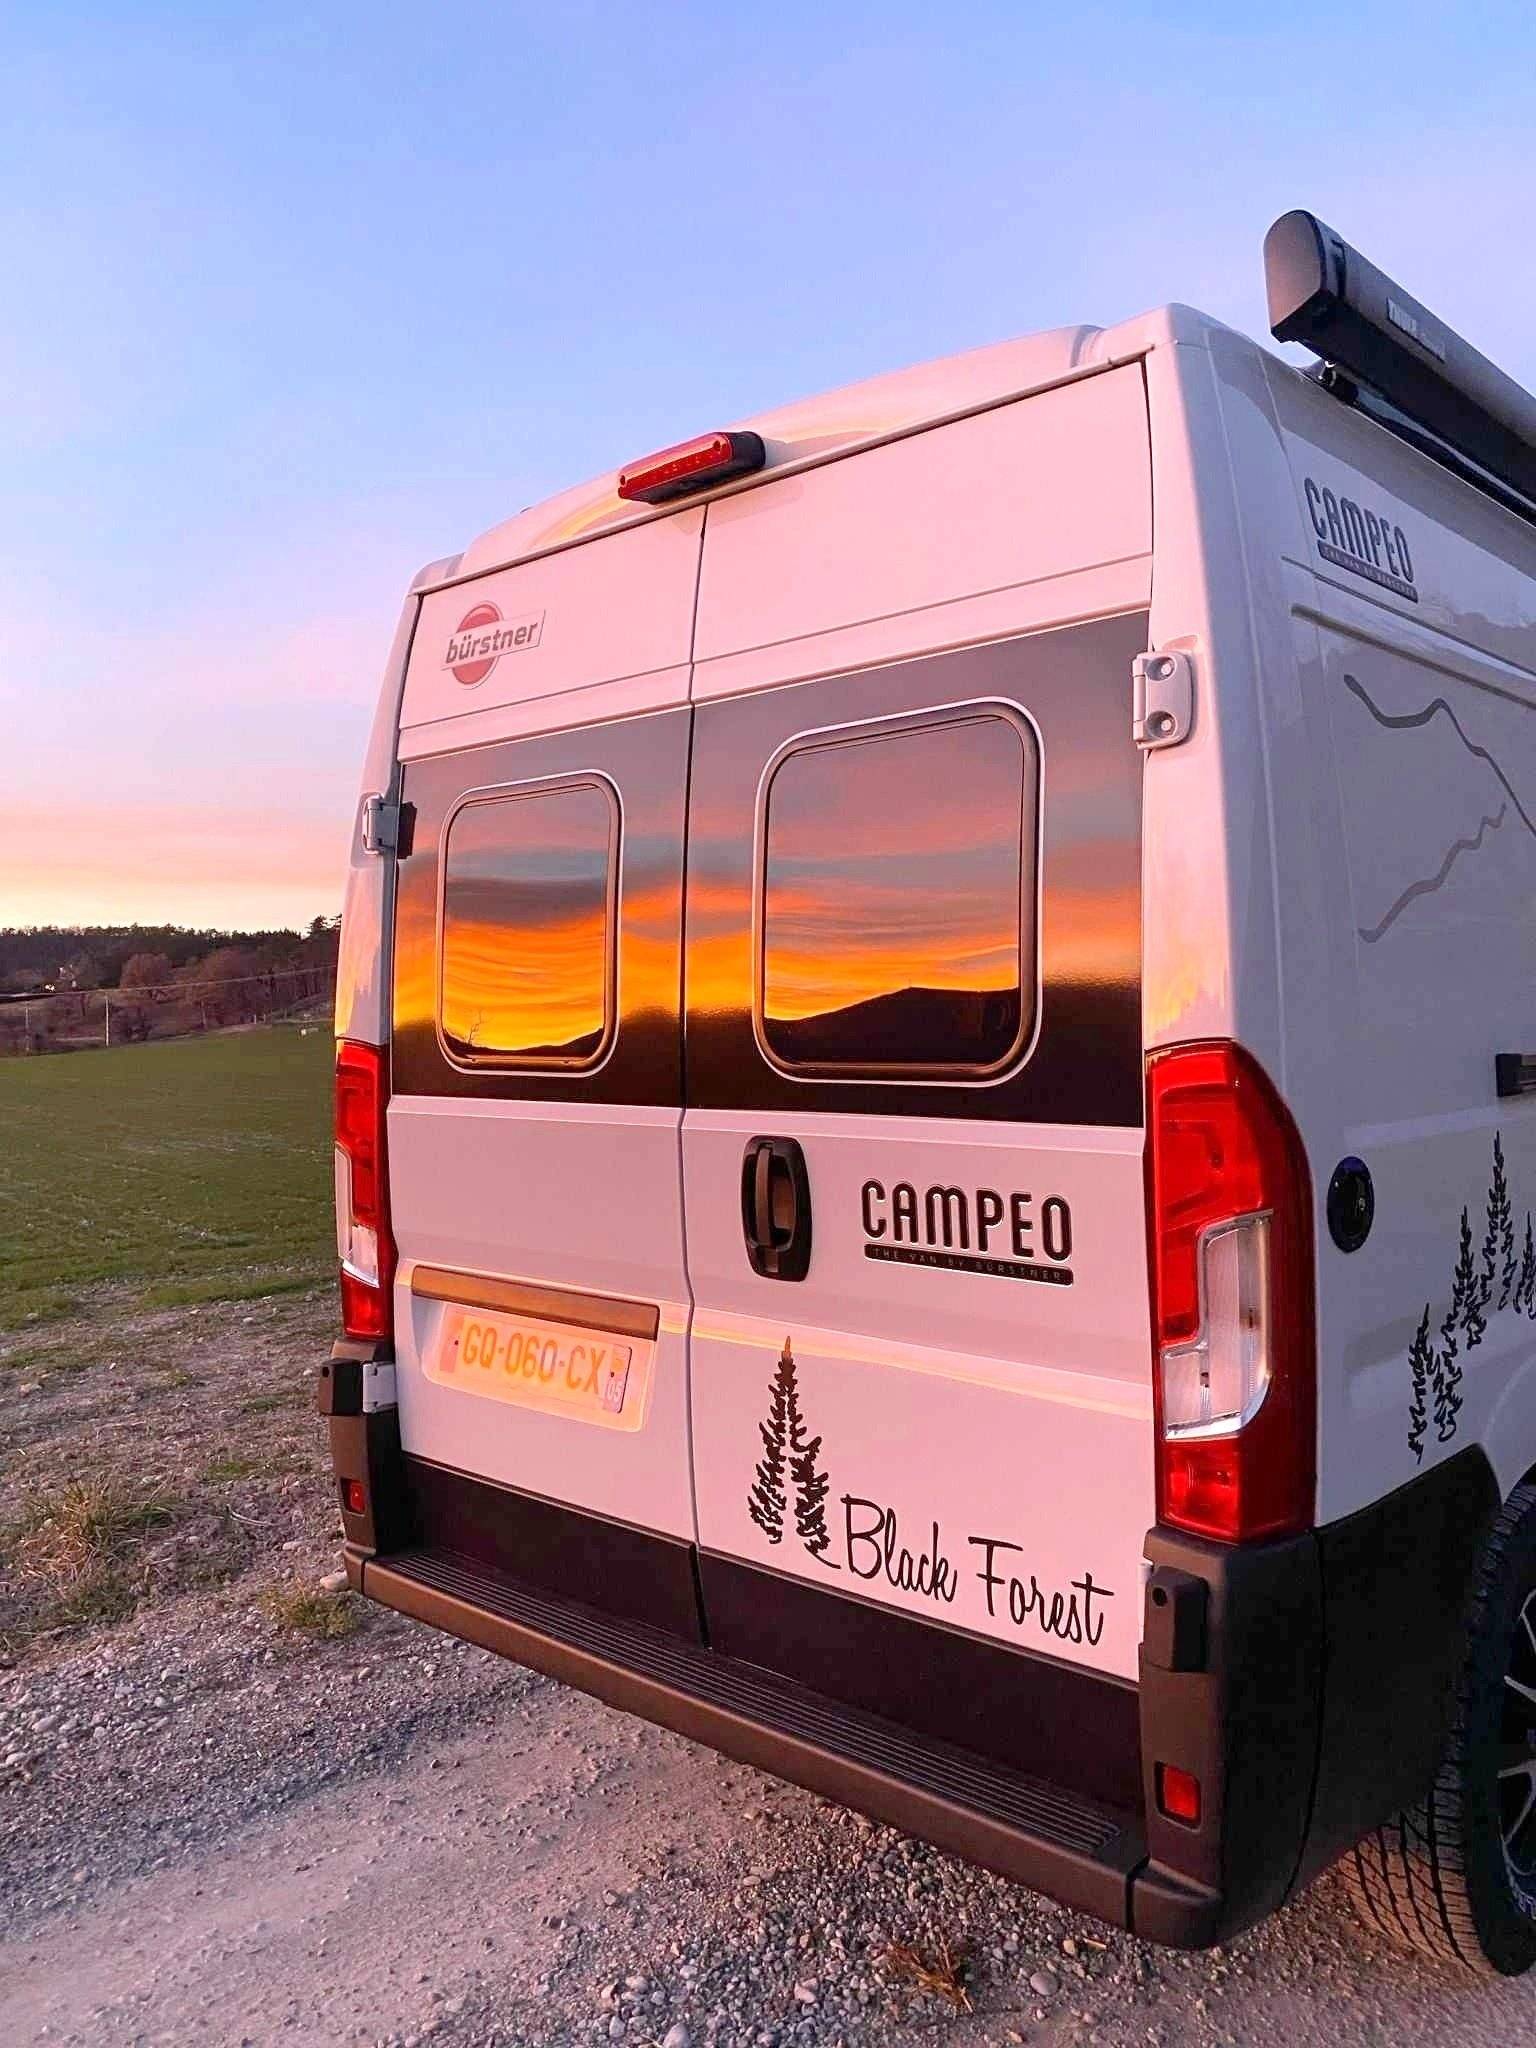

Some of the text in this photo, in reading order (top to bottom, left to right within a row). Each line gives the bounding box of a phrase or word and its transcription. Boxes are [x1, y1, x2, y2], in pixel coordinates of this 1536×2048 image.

[1304, 478, 1414, 583] CAMPEO
[445, 622, 538, 664] bürstner
[861, 1180, 1073, 1261] CAMPEO
[873, 1247, 900, 1259] THE
[909, 1253, 937, 1264] VAN
[840, 1494, 1115, 1646] Black Forest
